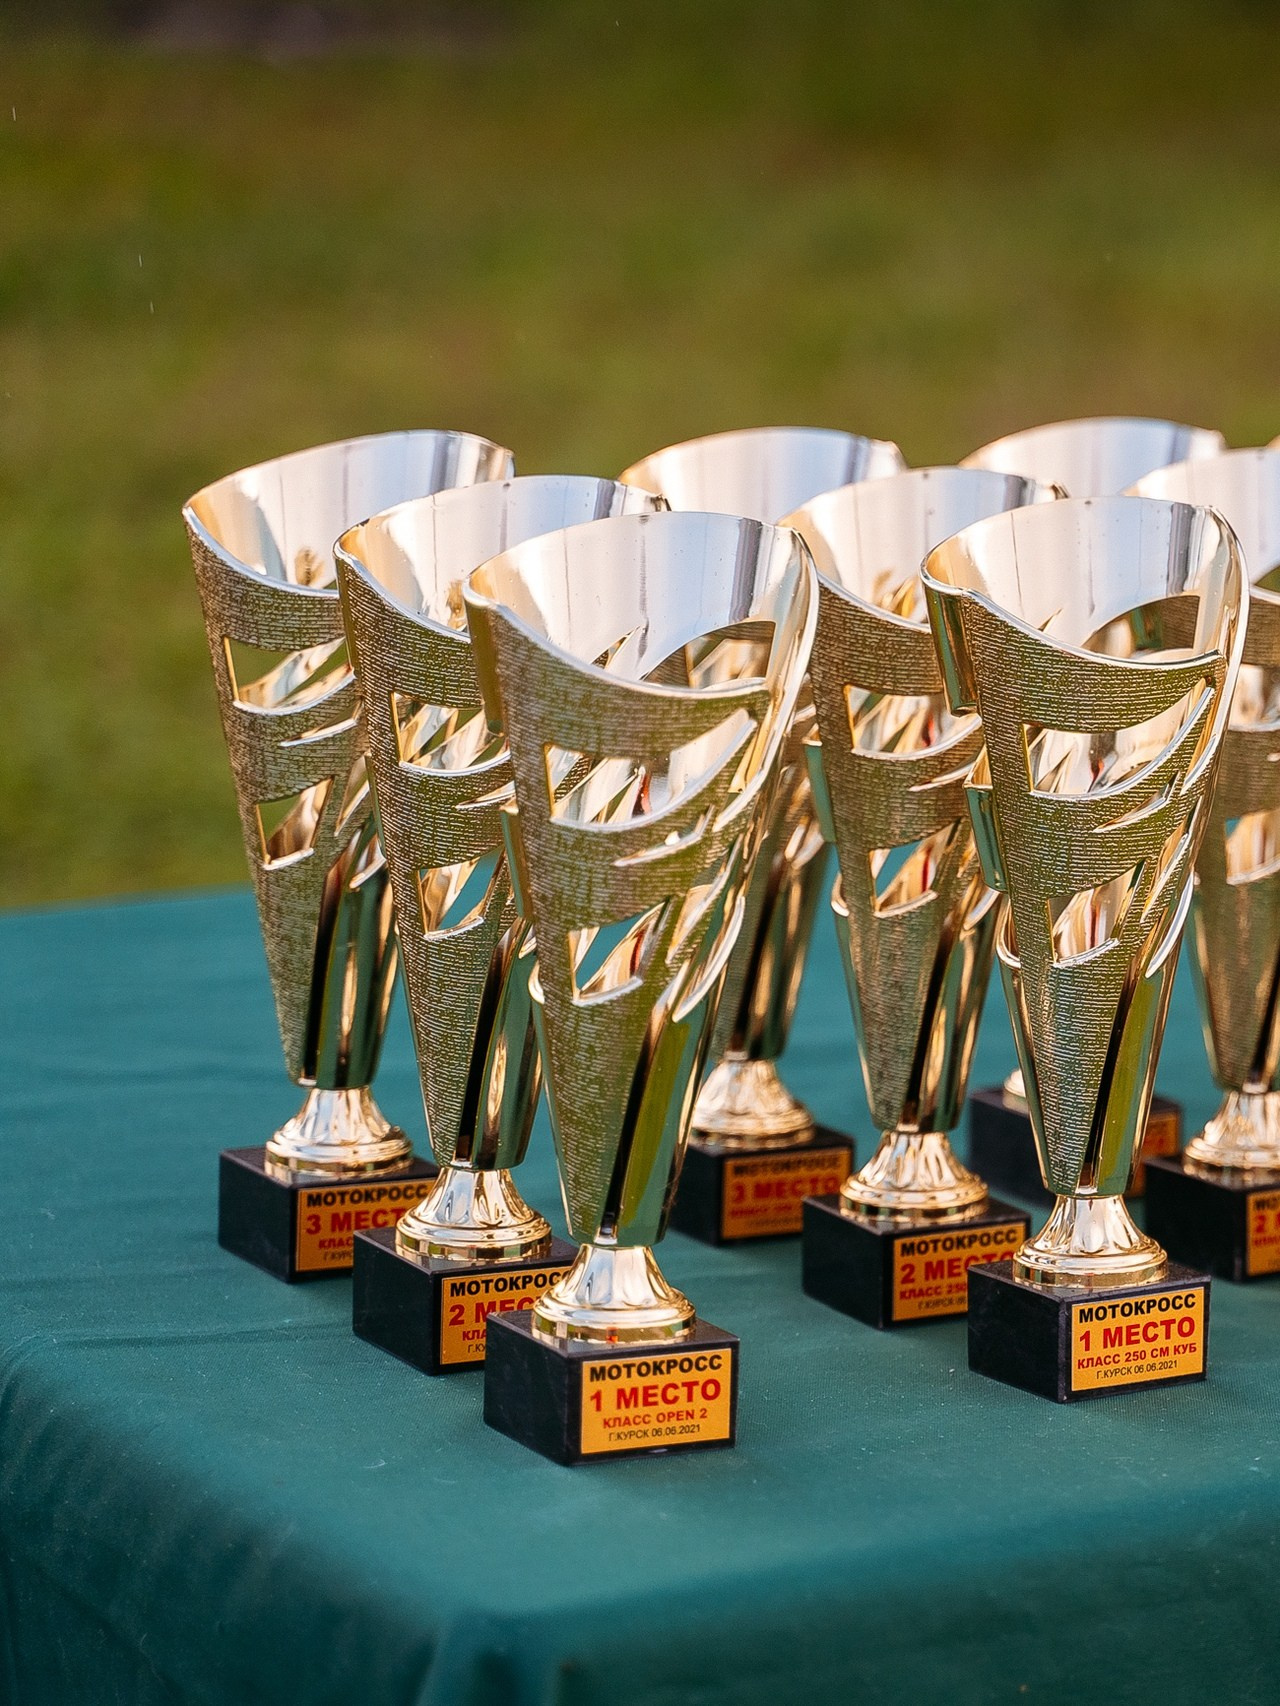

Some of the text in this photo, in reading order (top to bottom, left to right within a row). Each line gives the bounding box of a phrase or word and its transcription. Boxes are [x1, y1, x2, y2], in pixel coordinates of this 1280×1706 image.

[306, 1184, 429, 1208] МОТОКРОСС
[306, 1207, 408, 1236] 3 МЕСТ
[318, 1236, 353, 1250] КЛАС
[900, 1228, 1018, 1257] МОТОКРОСС
[900, 1263, 916, 1284] 2
[449, 1296, 541, 1327] 2 МЕС
[1079, 1293, 1196, 1324] МОТОКРОСС
[462, 1329, 487, 1341] КЛА
[1079, 1316, 1196, 1352] 1 МЕСТО
[590, 1354, 722, 1382] МОТОКРОСС
[1077, 1342, 1197, 1369] КЛАСС 250 СМ КУБ
[1133, 1360, 1178, 1374] 06.06.2021
[590, 1378, 721, 1412] 1 МЕСТО
[603, 1408, 708, 1429] КЛАСС OPEN 2
